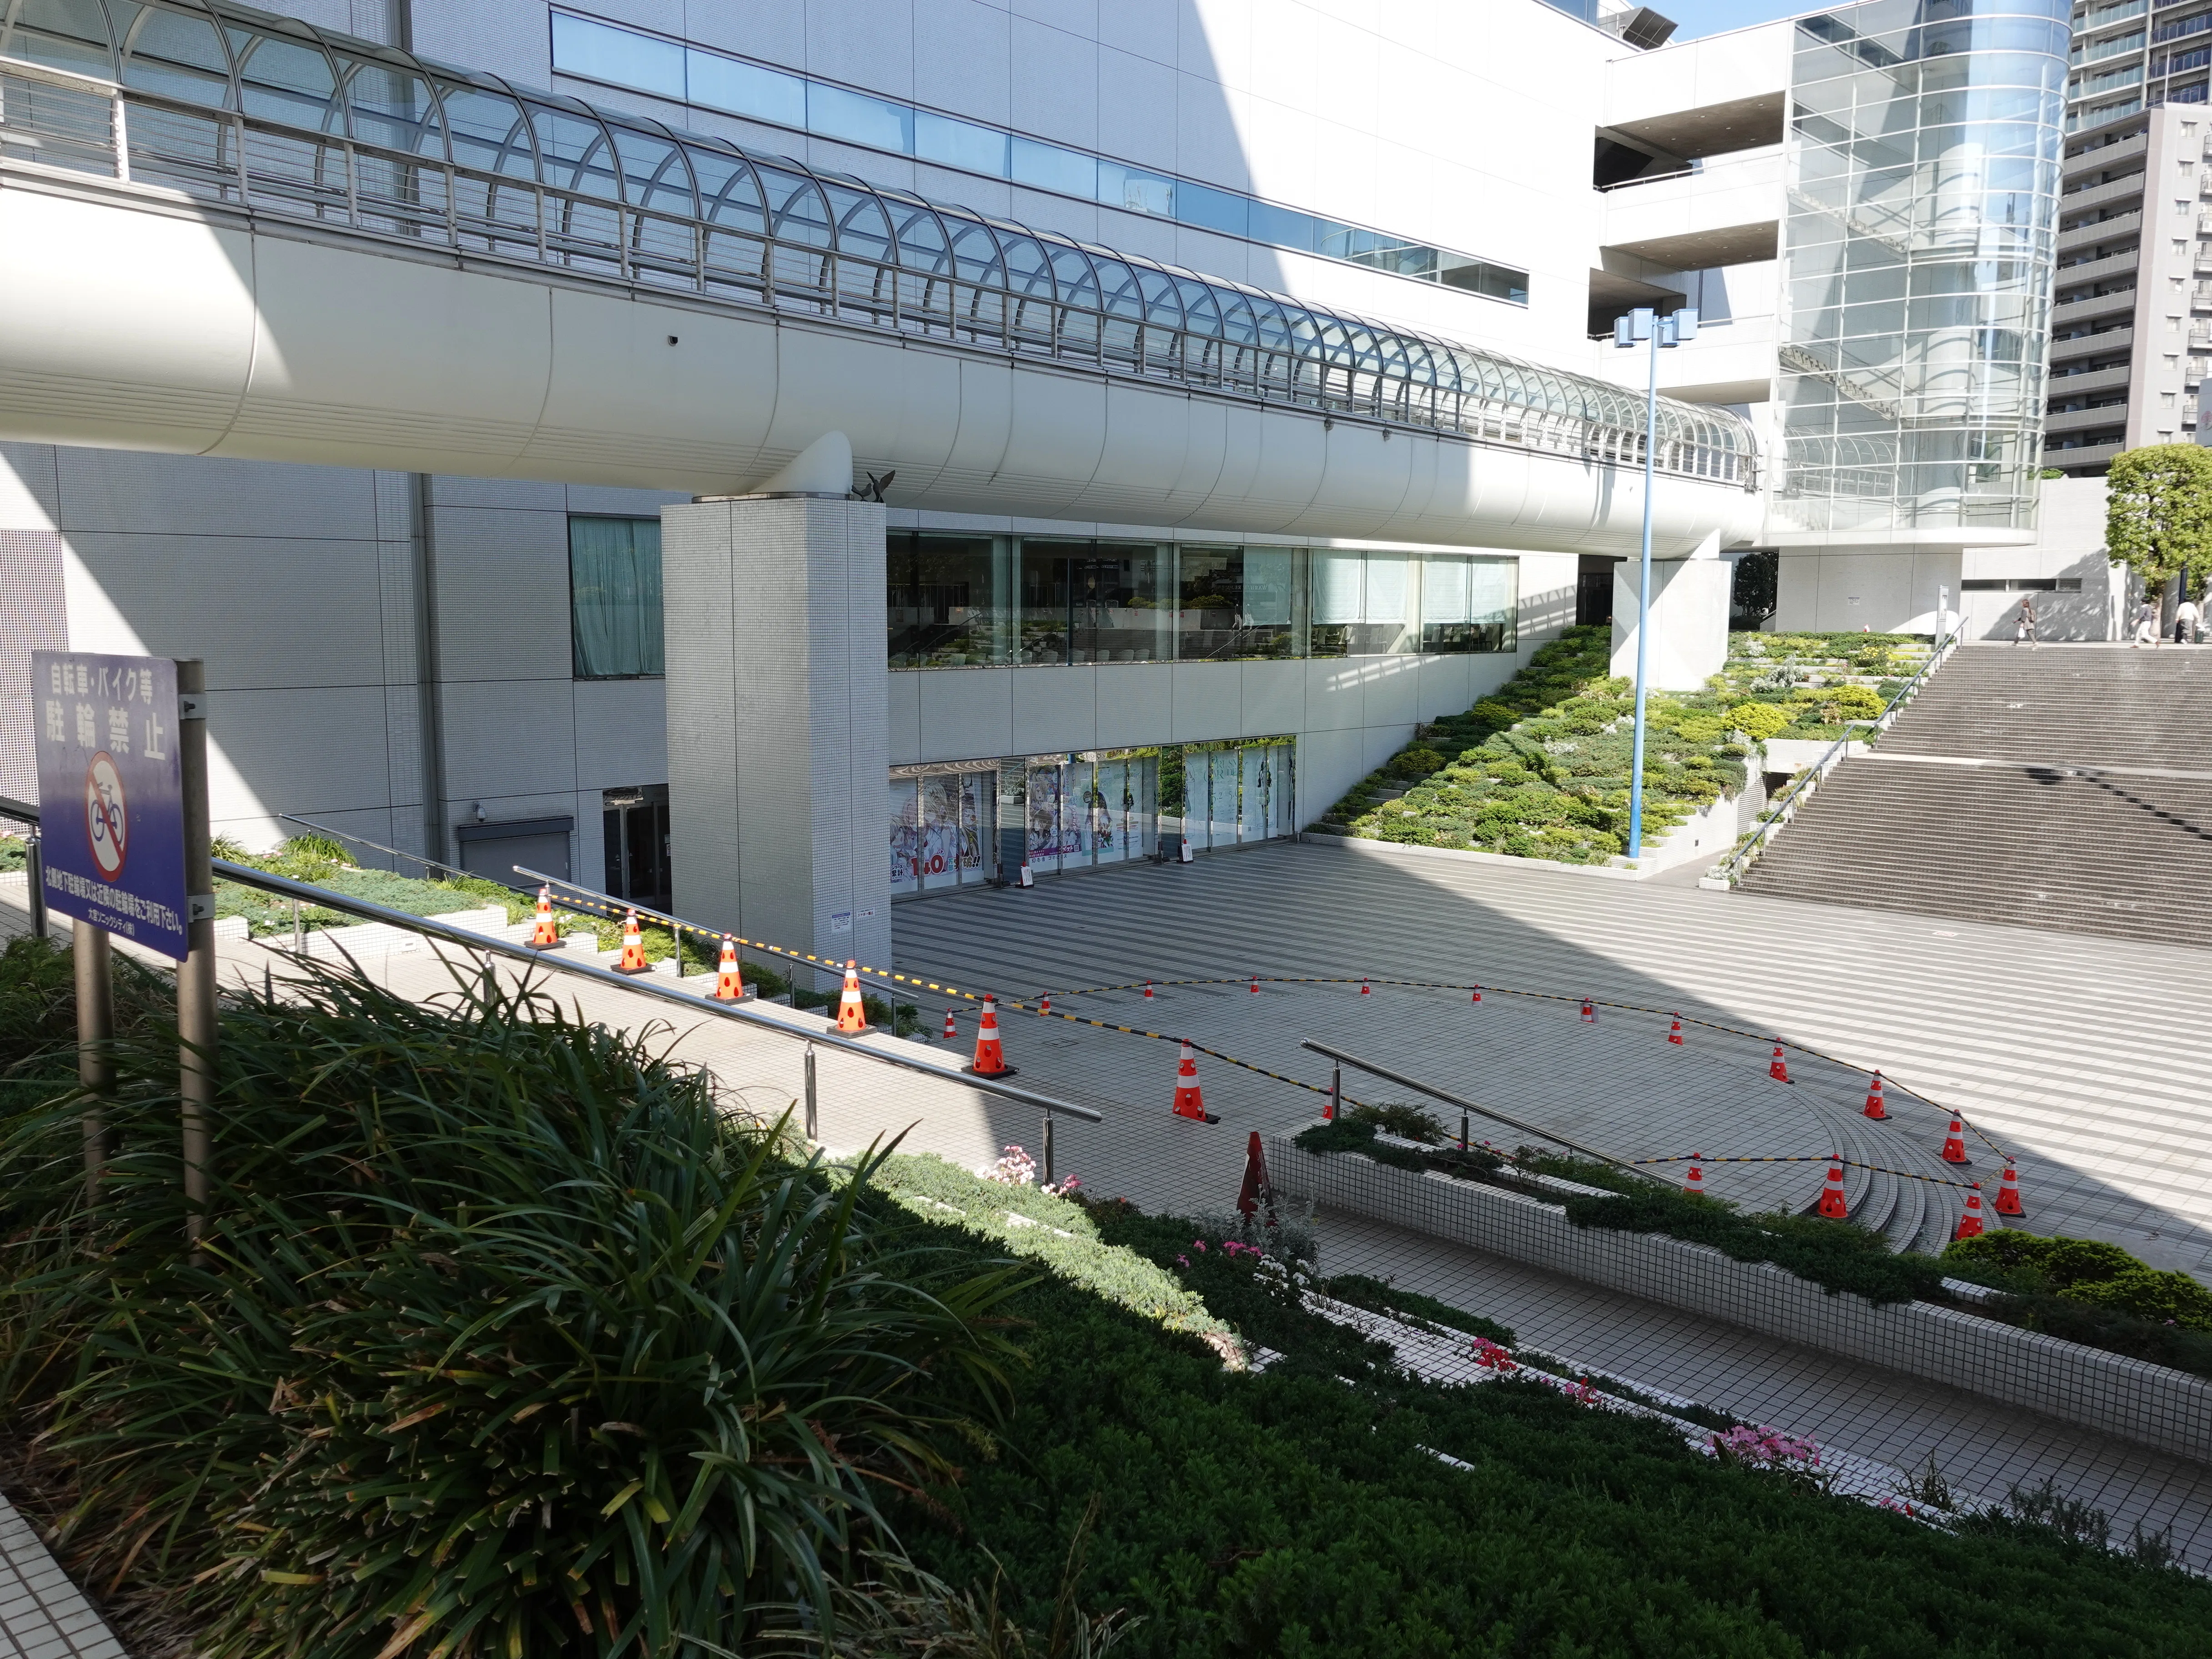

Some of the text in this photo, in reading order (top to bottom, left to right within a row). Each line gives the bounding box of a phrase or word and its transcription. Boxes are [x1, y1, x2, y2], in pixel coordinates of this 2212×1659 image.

[51, 662, 153, 705] 自転車・バイク等
[46, 699, 166, 760] 駐輪禁止
